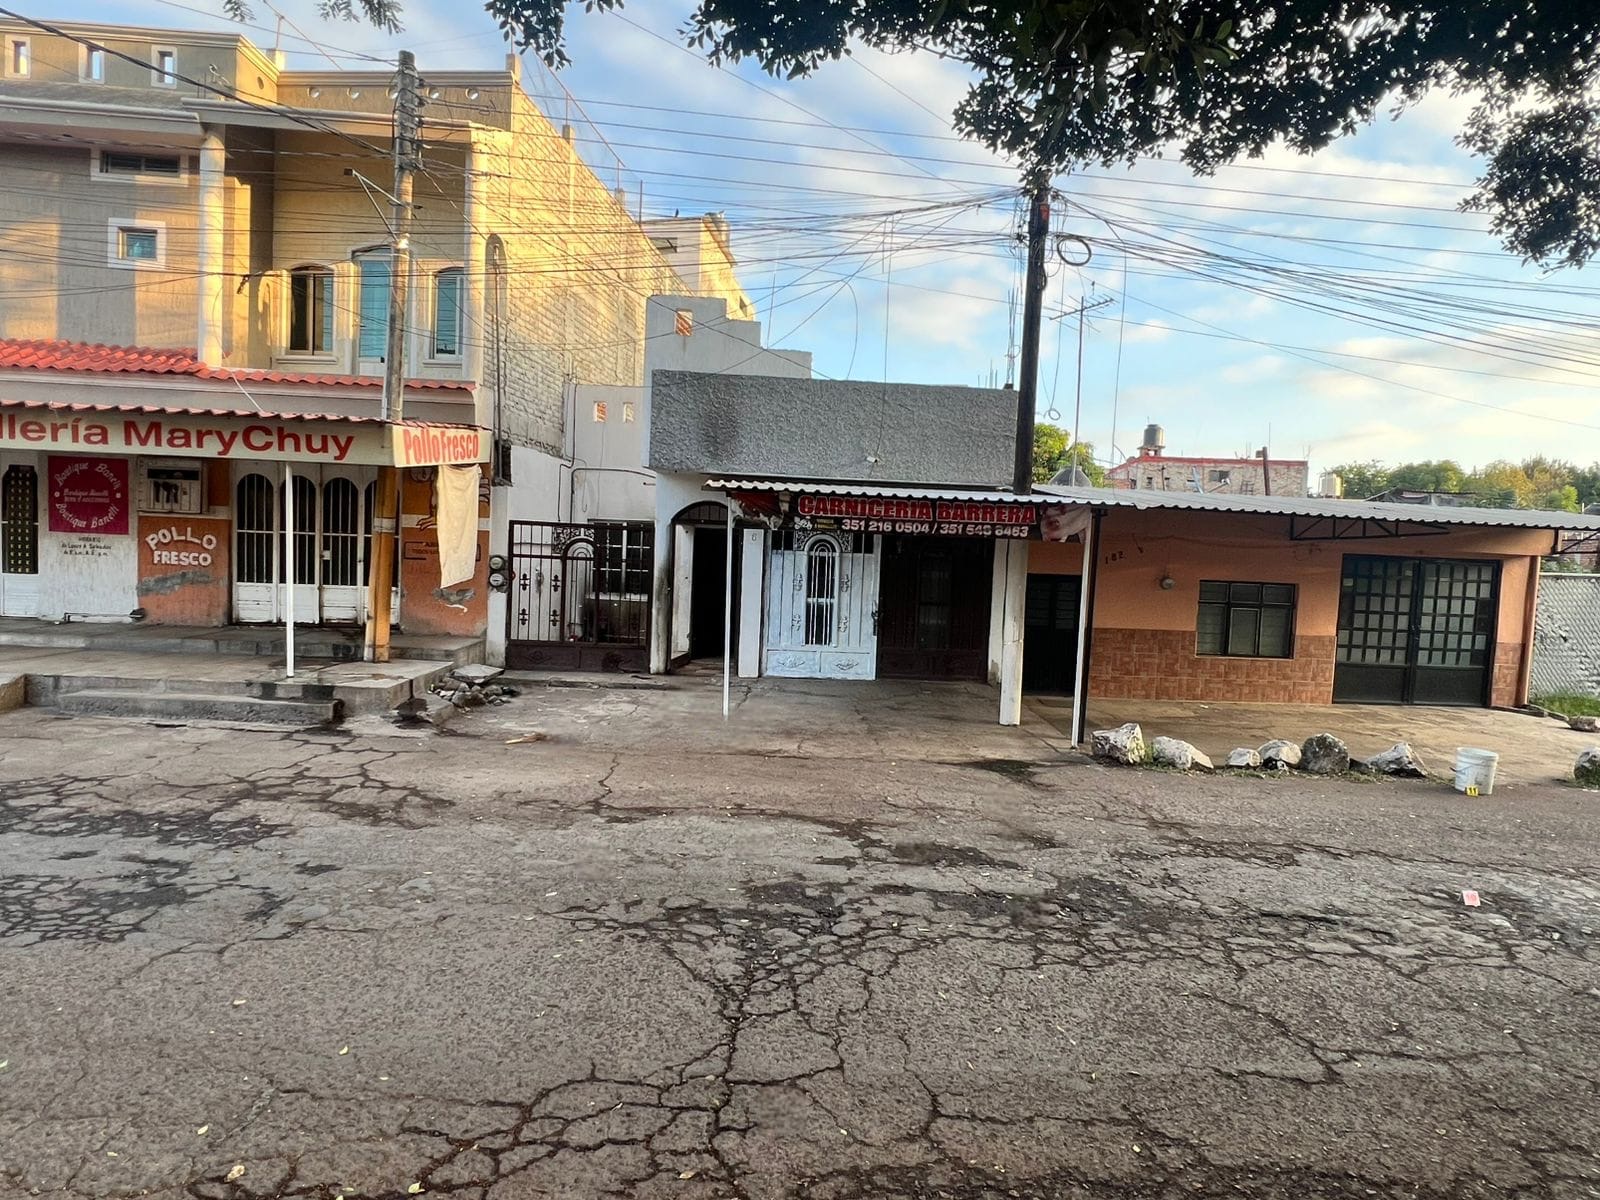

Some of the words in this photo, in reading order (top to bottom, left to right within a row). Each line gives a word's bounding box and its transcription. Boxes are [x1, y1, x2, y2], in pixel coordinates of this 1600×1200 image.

[124, 420, 354, 461] MaryChuy
[56, 503, 87, 528] Boutique
[798, 495, 932, 521] CARNICERIA
[936, 501, 1037, 524] BARRERA
[145, 526, 217, 550] POLLO
[841, 519, 865, 531] 351
[868, 520, 892, 532] 216
[895, 522, 930, 534] 0504
[940, 523, 964, 535] 351
[153, 550, 212, 566] FRESCO
